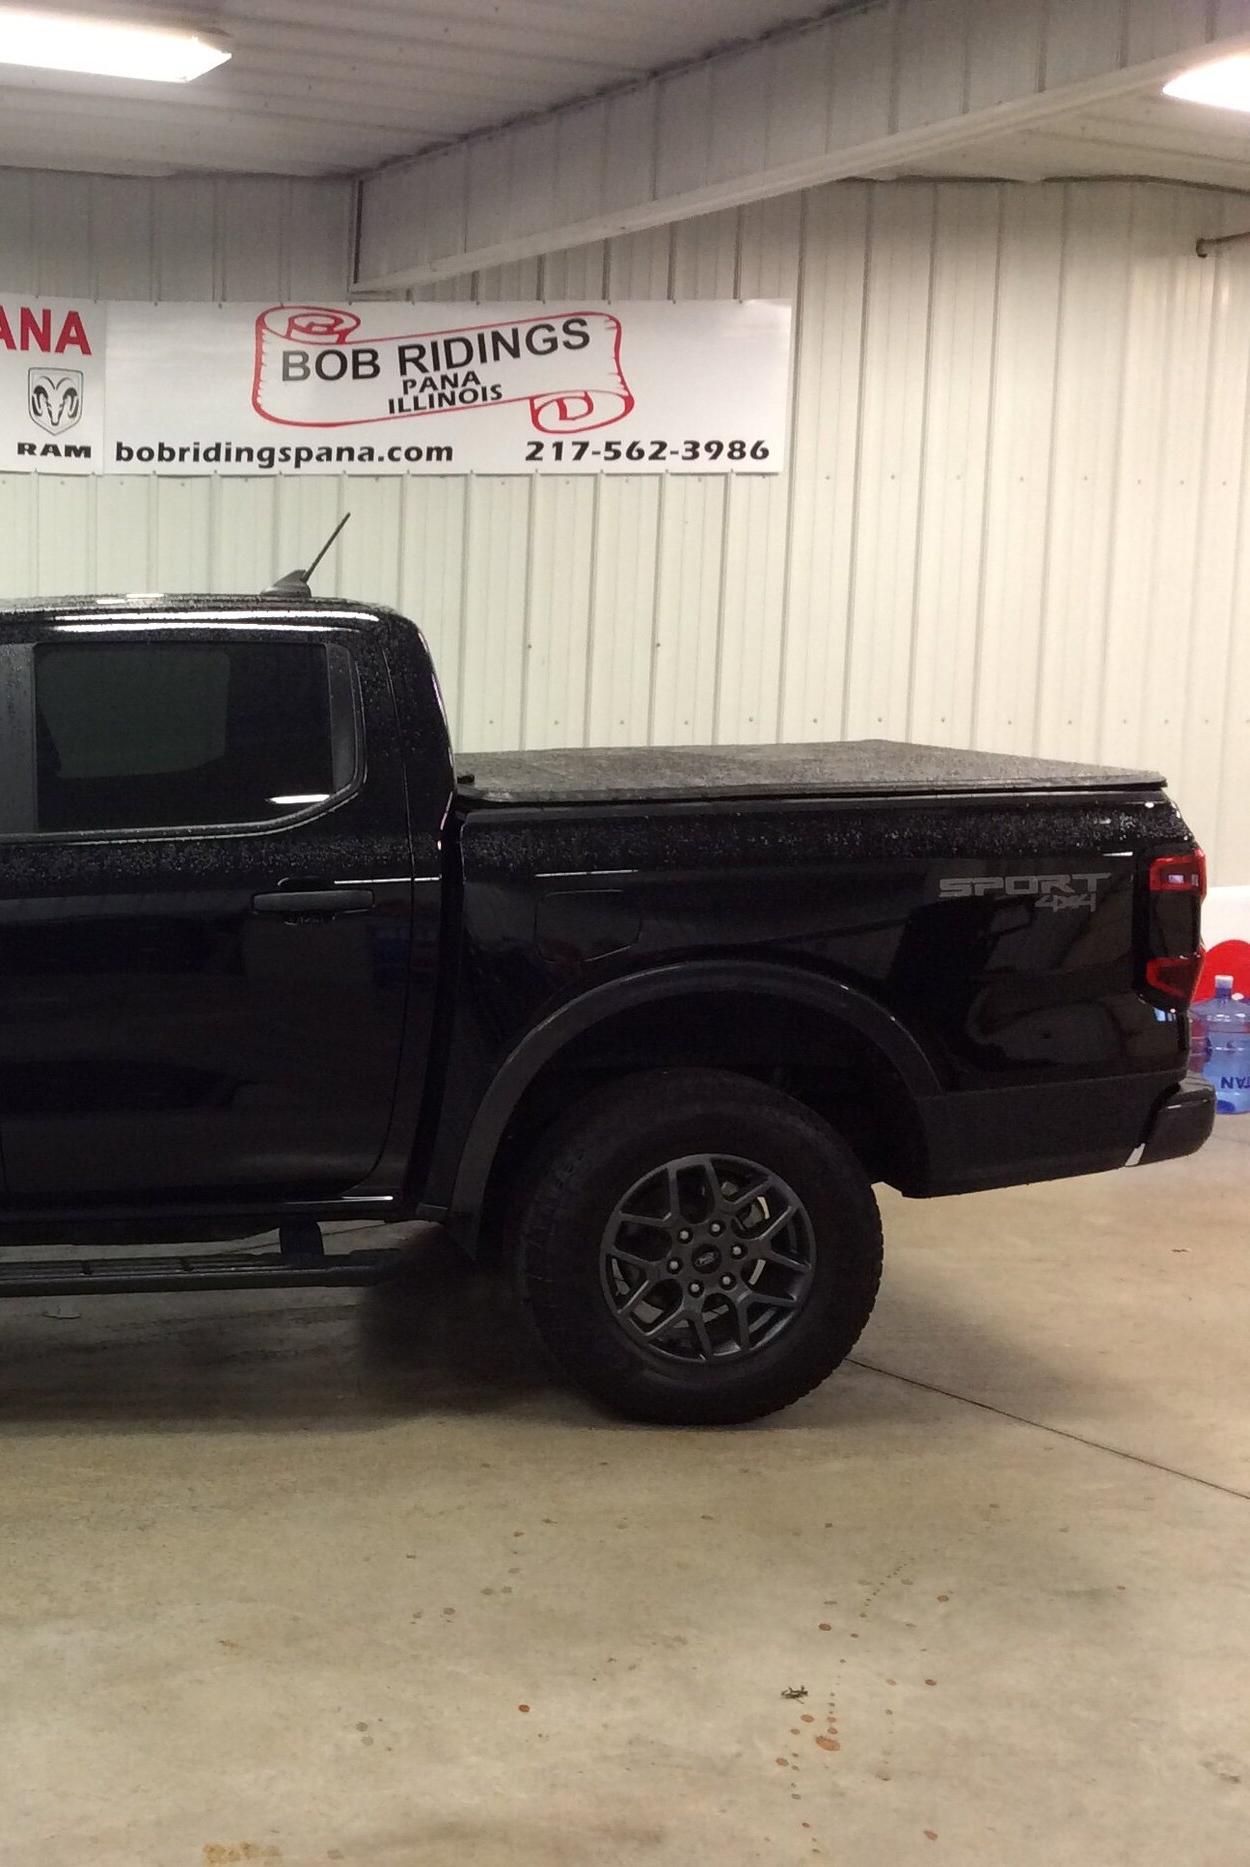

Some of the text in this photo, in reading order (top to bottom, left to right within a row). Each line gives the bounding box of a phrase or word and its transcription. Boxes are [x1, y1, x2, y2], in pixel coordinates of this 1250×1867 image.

[282, 317, 591, 382] BOB RIDINGS
[402, 370, 481, 395] PANA
[388, 384, 504, 414] ILLINOIS
[17, 442, 91, 458] RAM
[115, 441, 453, 468] bobridingspana.com
[525, 440, 770, 461] 217-562-3986
[939, 872, 1112, 898] SPORT
